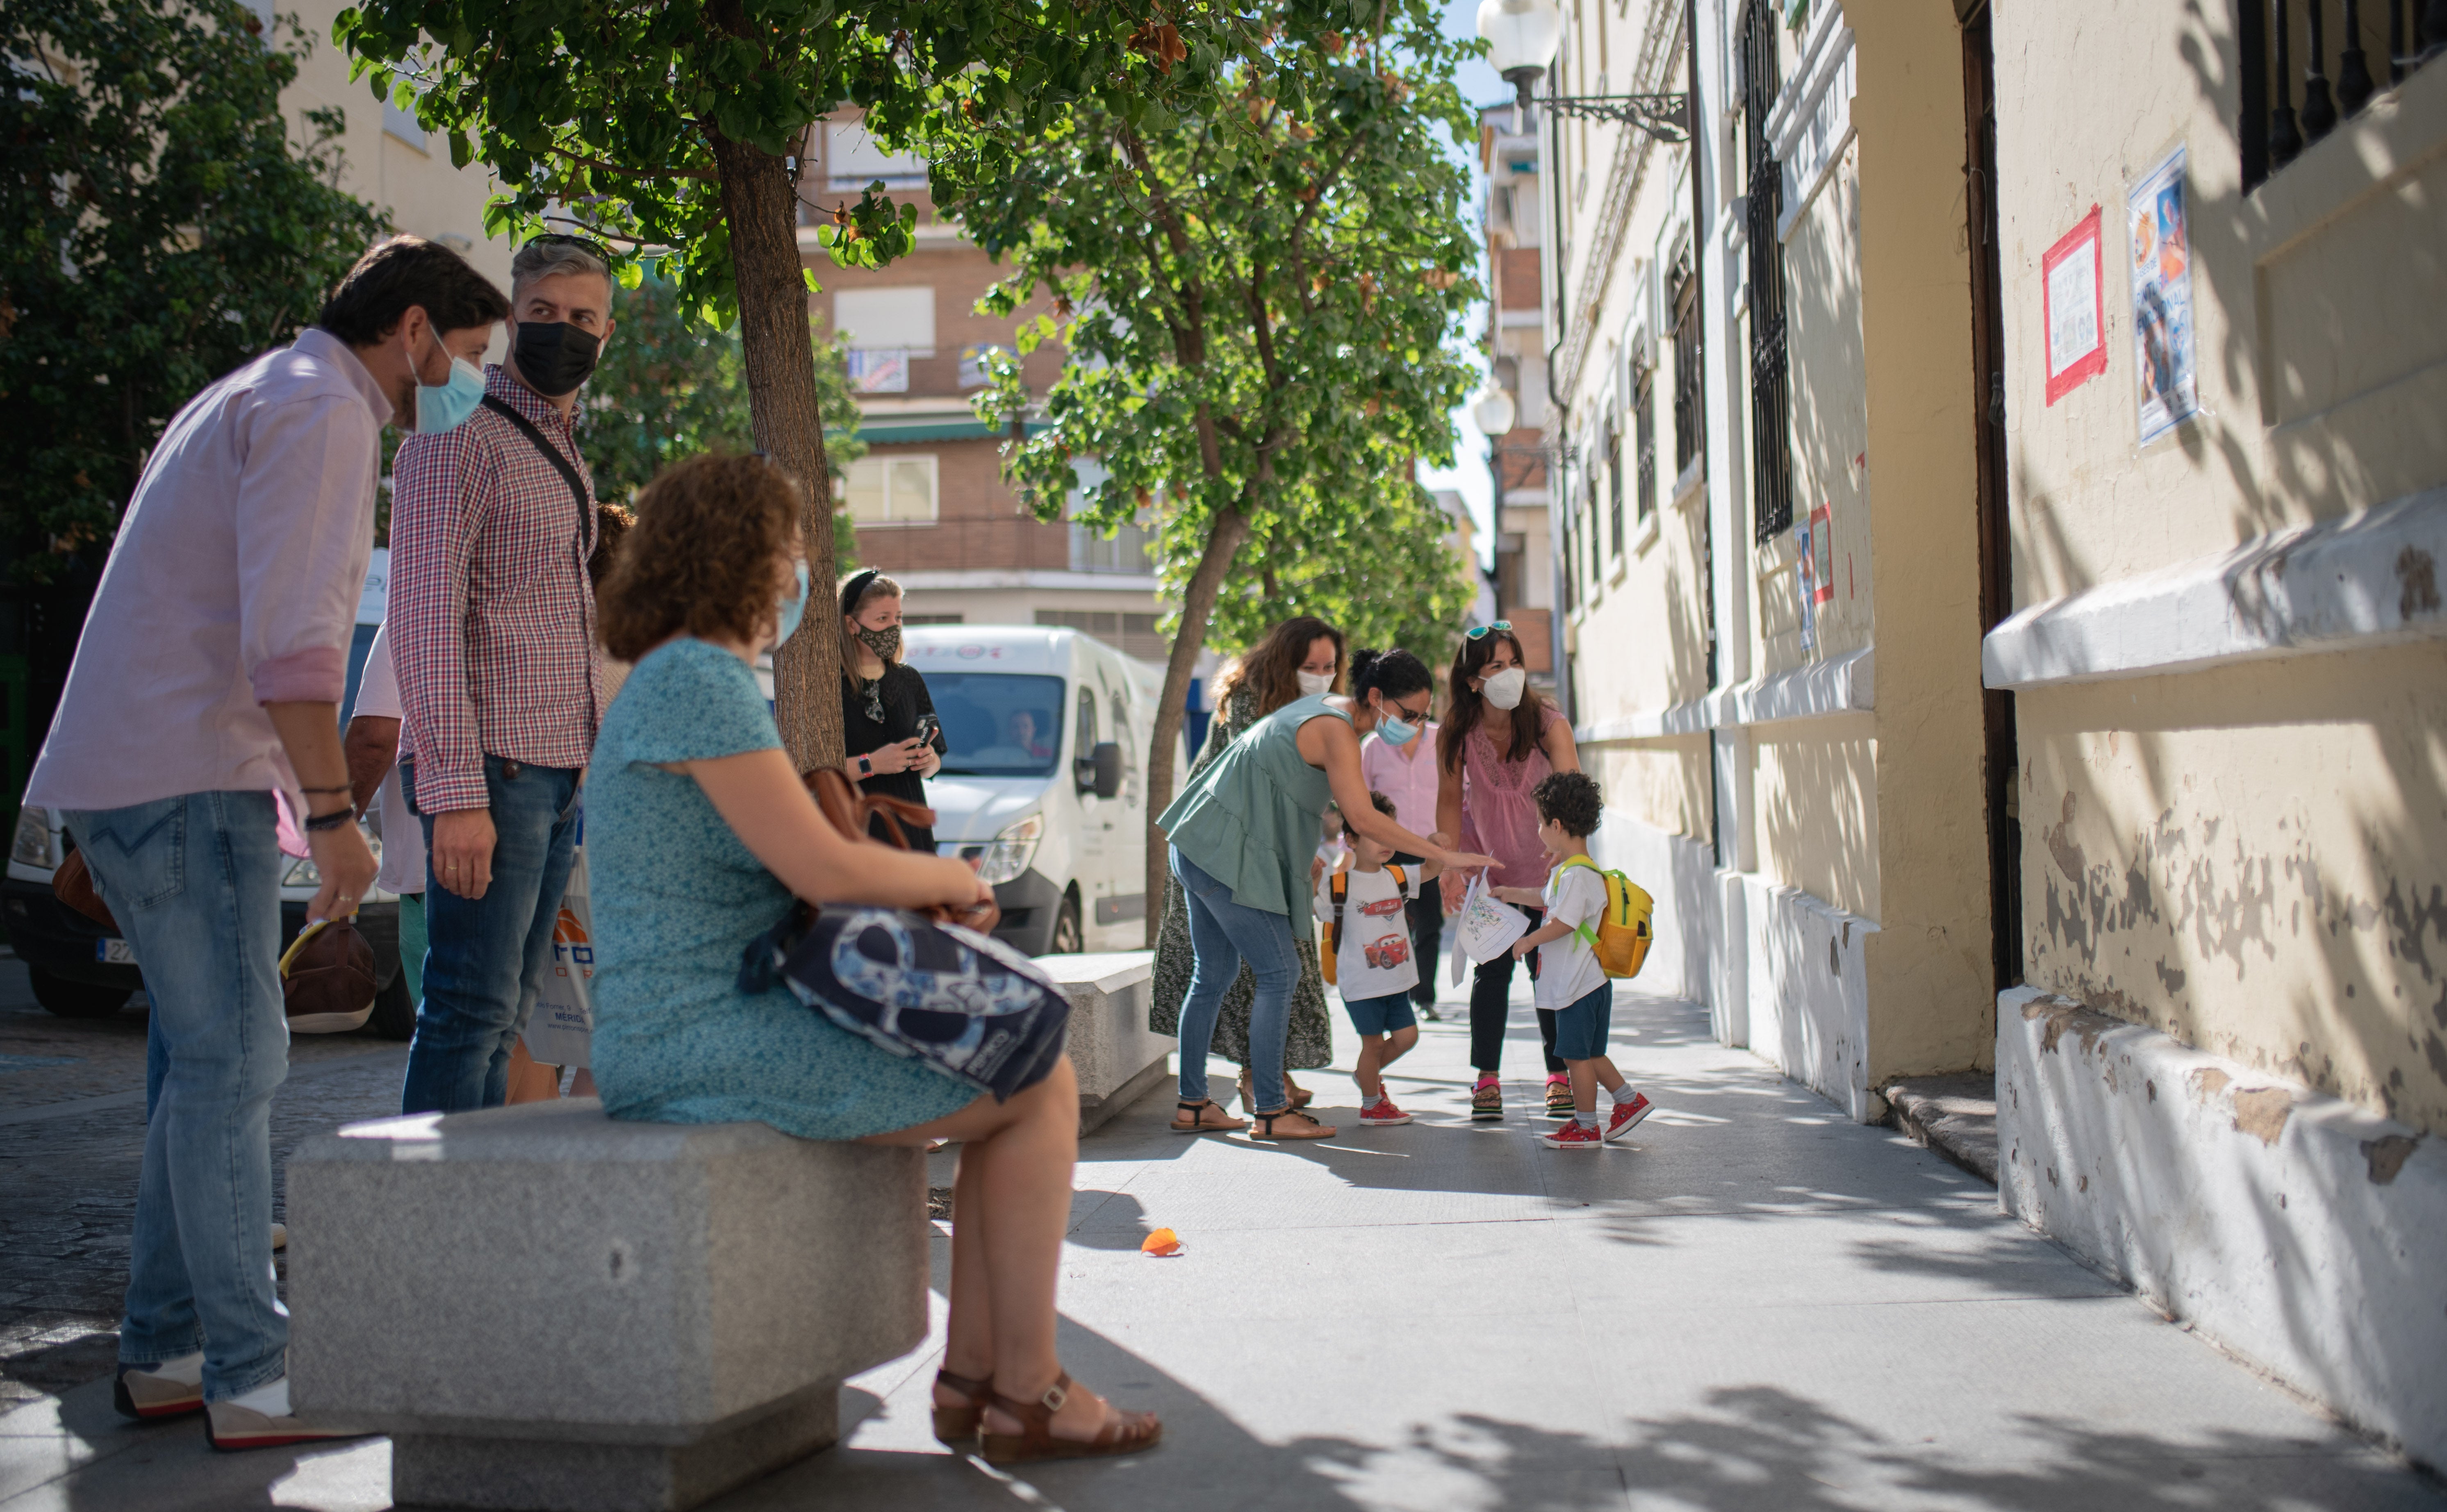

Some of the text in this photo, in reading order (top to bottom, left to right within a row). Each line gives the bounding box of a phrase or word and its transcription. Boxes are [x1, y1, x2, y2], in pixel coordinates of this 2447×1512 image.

[2151, 258, 2157, 271] DE
[2137, 270, 2169, 305] PINTURA
[2137, 289, 2185, 336] EMOCIONAL
